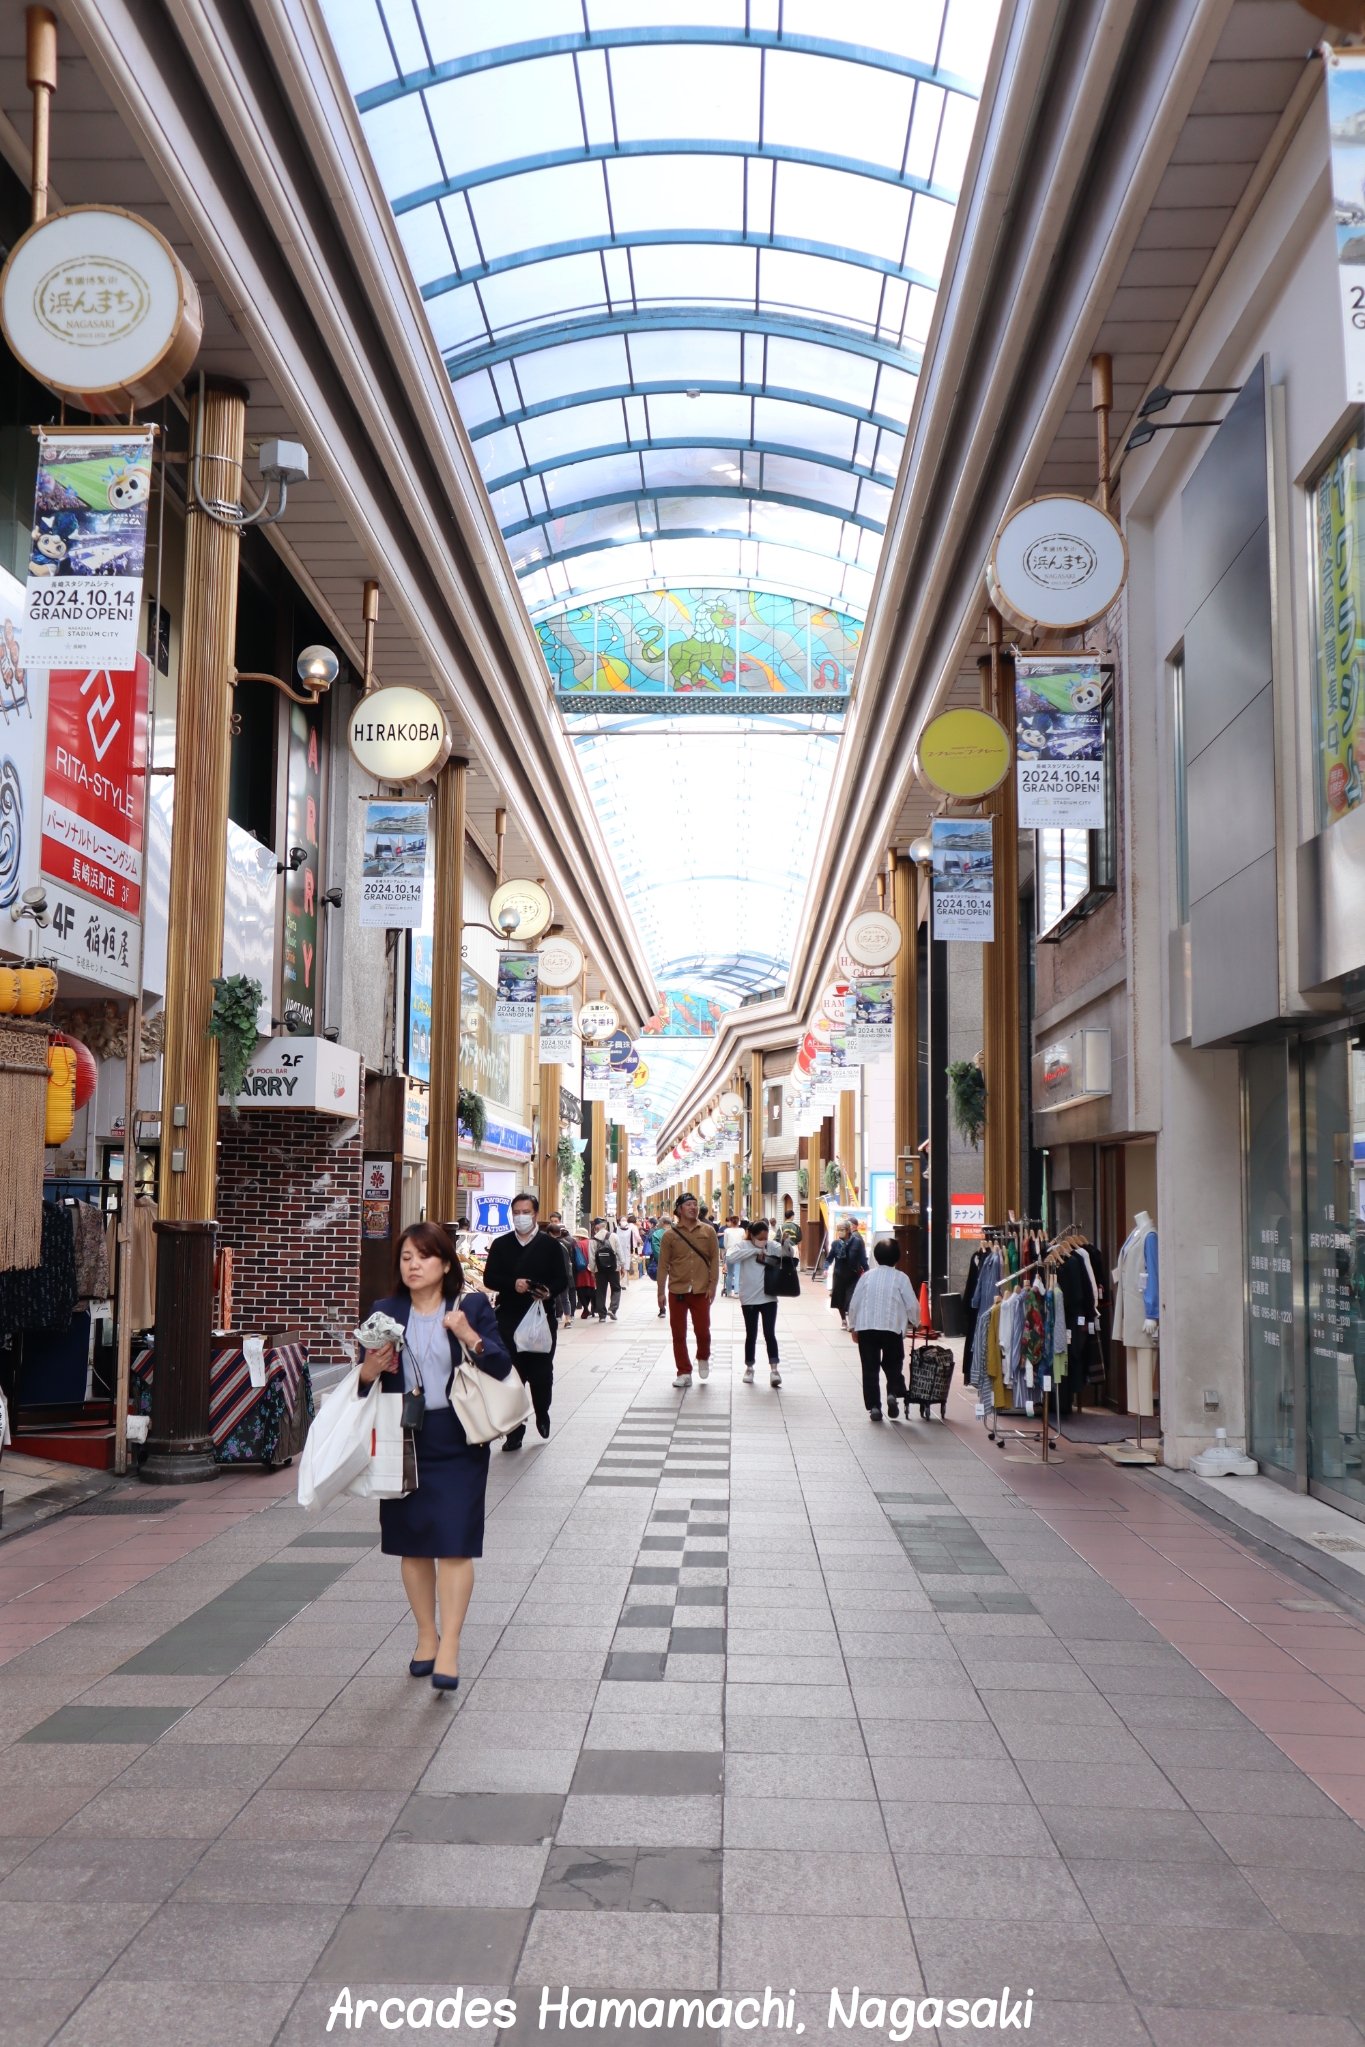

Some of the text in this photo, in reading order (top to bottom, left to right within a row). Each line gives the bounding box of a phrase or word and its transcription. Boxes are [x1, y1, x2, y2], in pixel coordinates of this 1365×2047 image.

[50, 289, 135, 314] 浜んまち
[66, 320, 115, 329] NAGASAKI
[1033, 554, 1088, 570] 浜んまち
[51, 580, 115, 588] 長崎スタジアムシティ
[31, 589, 136, 607] 2024.10.14
[29, 607, 133, 621] GRAND OPEN!
[353, 723, 440, 742] HIRAKOBA
[56, 745, 134, 819] RITA-STYLE
[1022, 770, 1100, 783] 2024.10.14
[1022, 783, 1100, 793] GRAND OPEN!
[47, 810, 138, 876] パーソナルトレーニングジム
[72, 858, 130, 904] 長崎浜町店 3F
[364, 883, 421, 894] 2024.10.14
[363, 893, 421, 902] GRAND OPEN!
[936, 898, 991, 909] 2024.10.14
[936, 907, 991, 916] GRAND OPEN!
[52, 902, 75, 940] 4F
[286, 915, 297, 932] Darts
[841, 956, 857, 966] HA
[497, 1005, 534, 1013] 2024.10.14
[823, 999, 845, 1008] HAM
[834, 1009, 844, 1018] Ca
[281, 1053, 304, 1067] 2F
[219, 1076, 298, 1097] ARRY
[477, 1196, 510, 1206] LAWSON
[954, 1210, 984, 1220] テナント
[1324, 1204, 1335, 1221] 1階
[477, 1223, 509, 1234] STATION
[1251, 1256, 1291, 1273] 各種保険・労災保険
[1251, 1281, 1269, 1296] 交通事故
[1261, 1307, 1292, 1324] 095-801-1220
